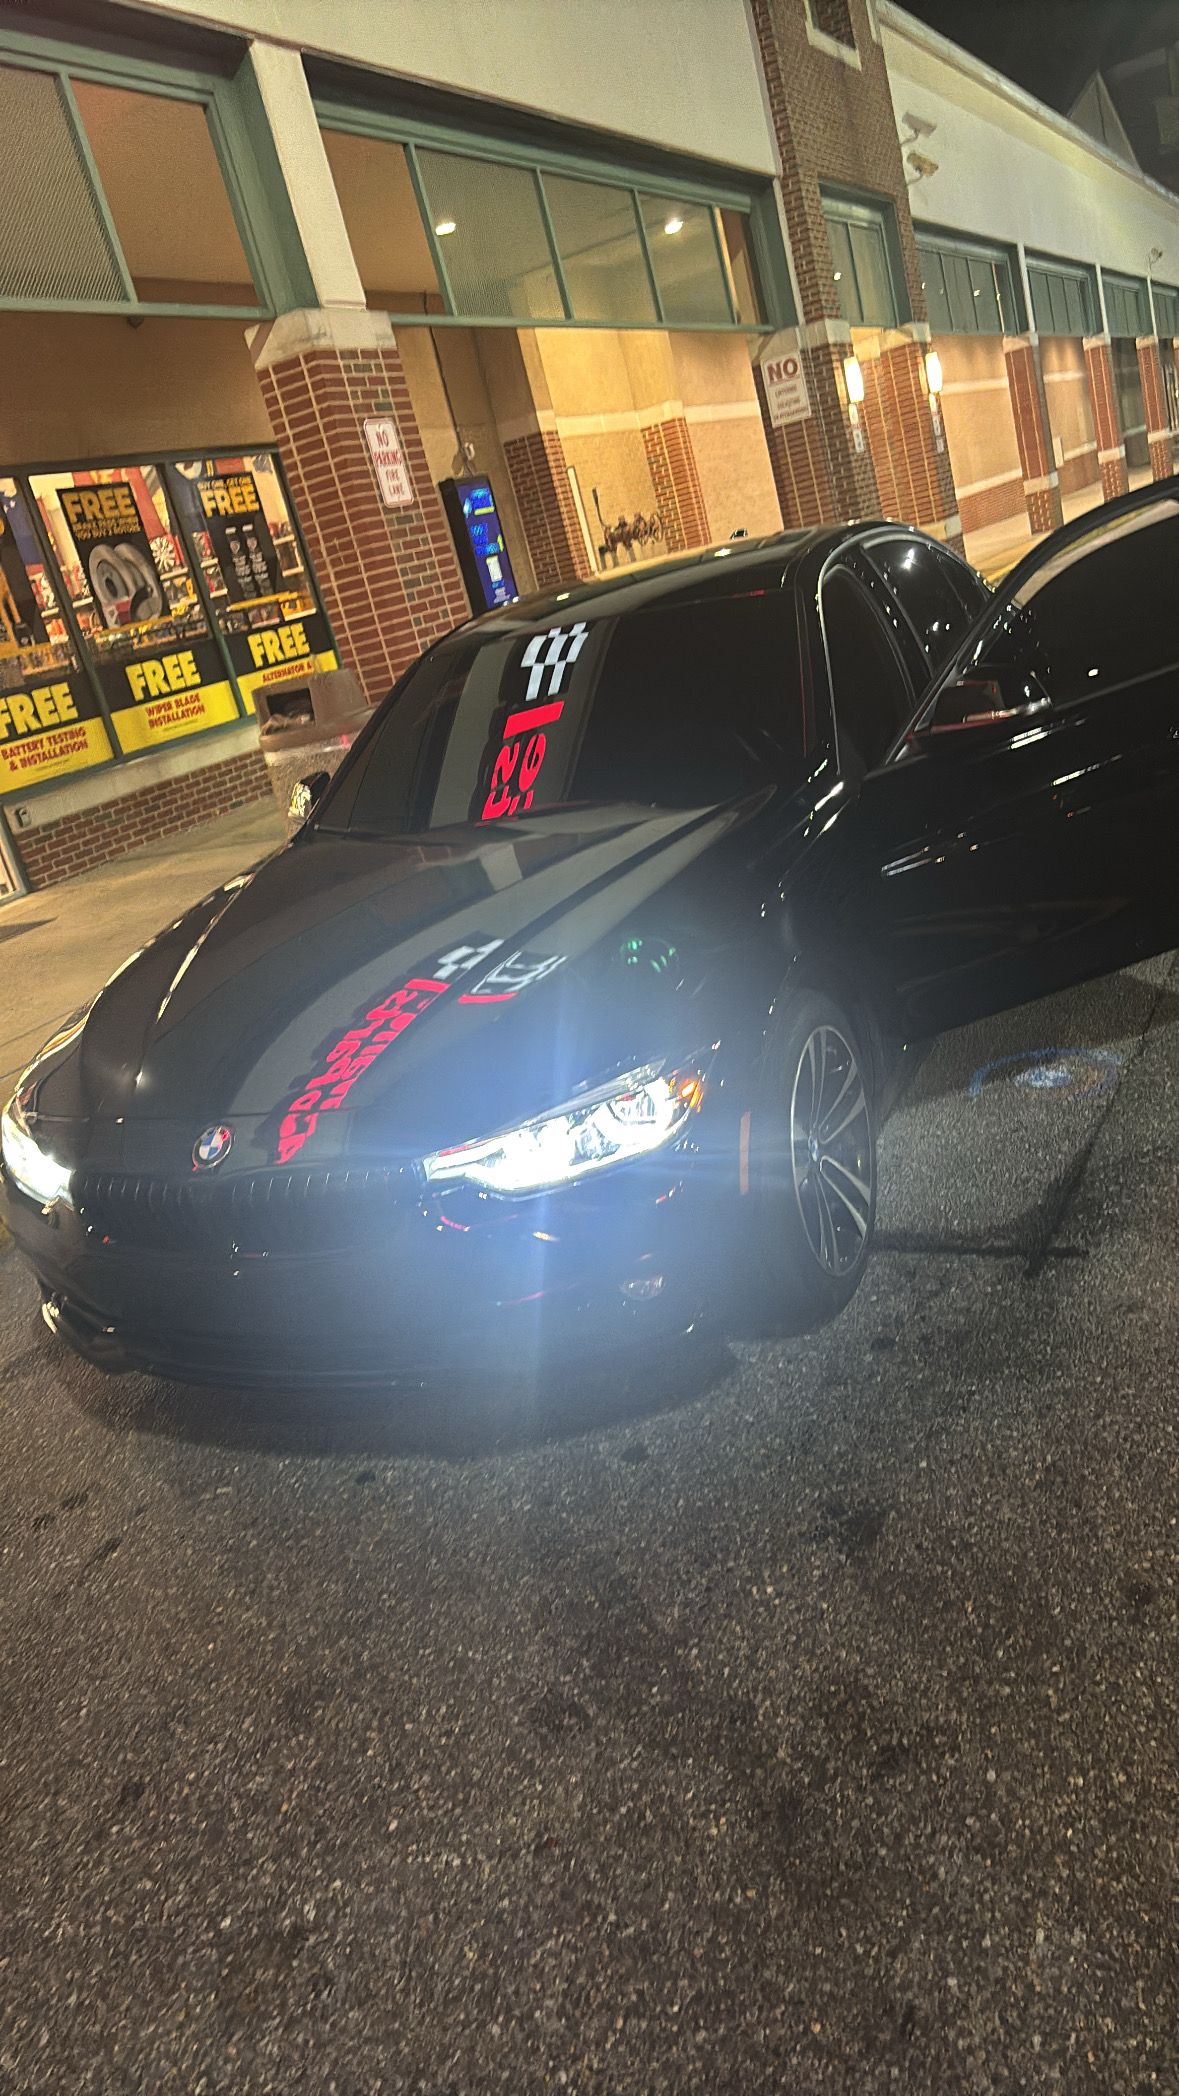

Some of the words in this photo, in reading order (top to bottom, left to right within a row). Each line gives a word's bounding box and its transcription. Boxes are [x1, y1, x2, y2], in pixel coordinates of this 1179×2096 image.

[767, 357, 798, 382] NO
[375, 430, 390, 447] NO
[373, 449, 402, 468] PARKING
[62, 487, 136, 525] FREE
[200, 484, 260, 518] FREE
[247, 622, 311, 668] FREE
[125, 650, 201, 702] FREE
[262, 662, 304, 683] ALTERNATOR
[0, 682, 79, 740] FREE
[145, 700, 172, 717] WIPER
[174, 692, 201, 709] BLADE
[148, 703, 206, 730] INSTALLATION
[1, 738, 44, 760] BATTERY
[46, 726, 86, 747] TESTING
[9, 760, 18, 772] &
[20, 739, 88, 769] INSTALLATION
